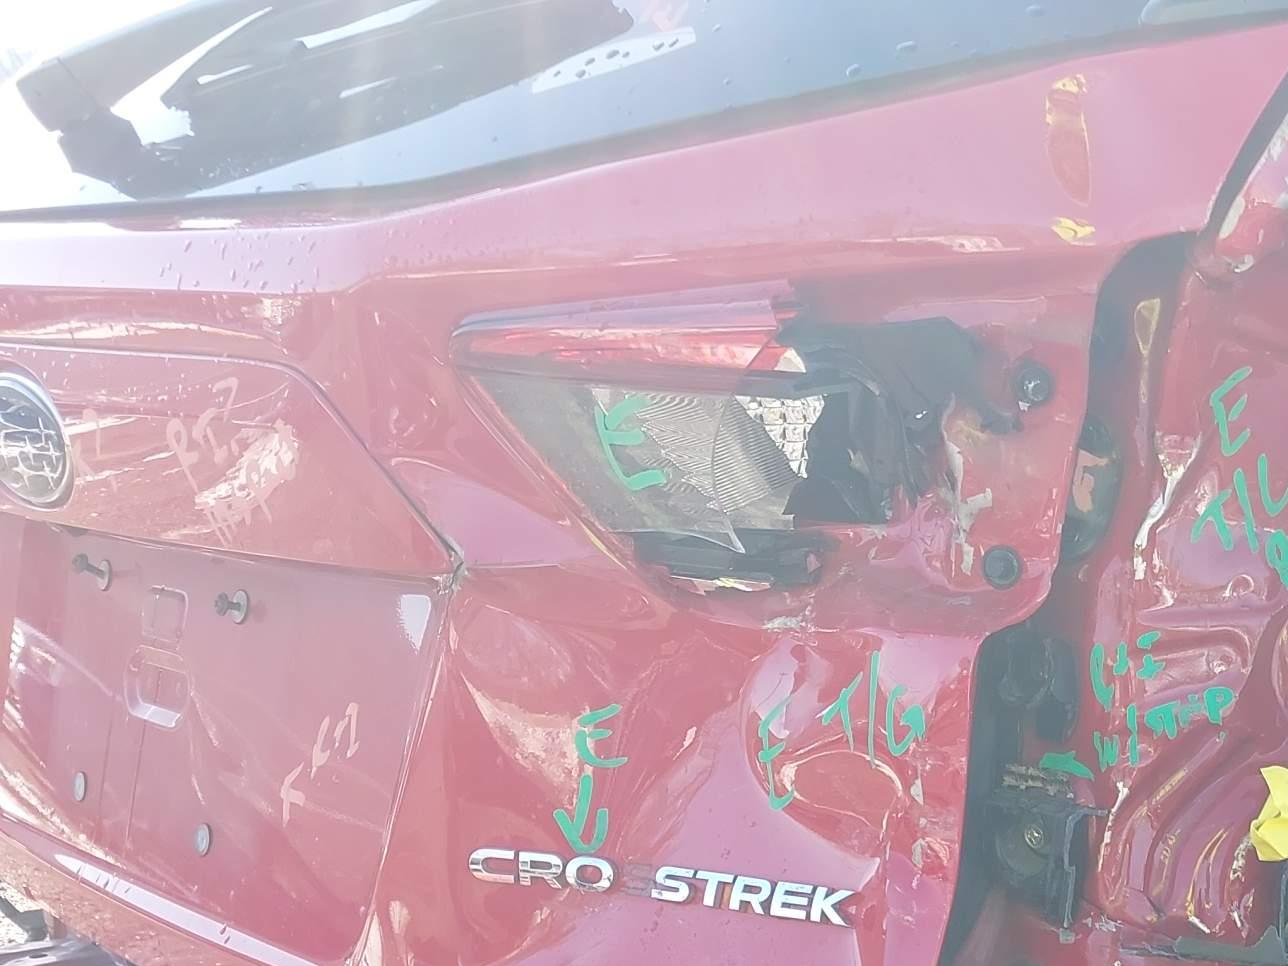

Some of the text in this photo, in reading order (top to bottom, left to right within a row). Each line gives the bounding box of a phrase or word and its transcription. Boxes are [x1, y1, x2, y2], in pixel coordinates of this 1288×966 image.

[595, 392, 673, 492] E
[1210, 366, 1252, 457] E
[574, 703, 629, 767] E
